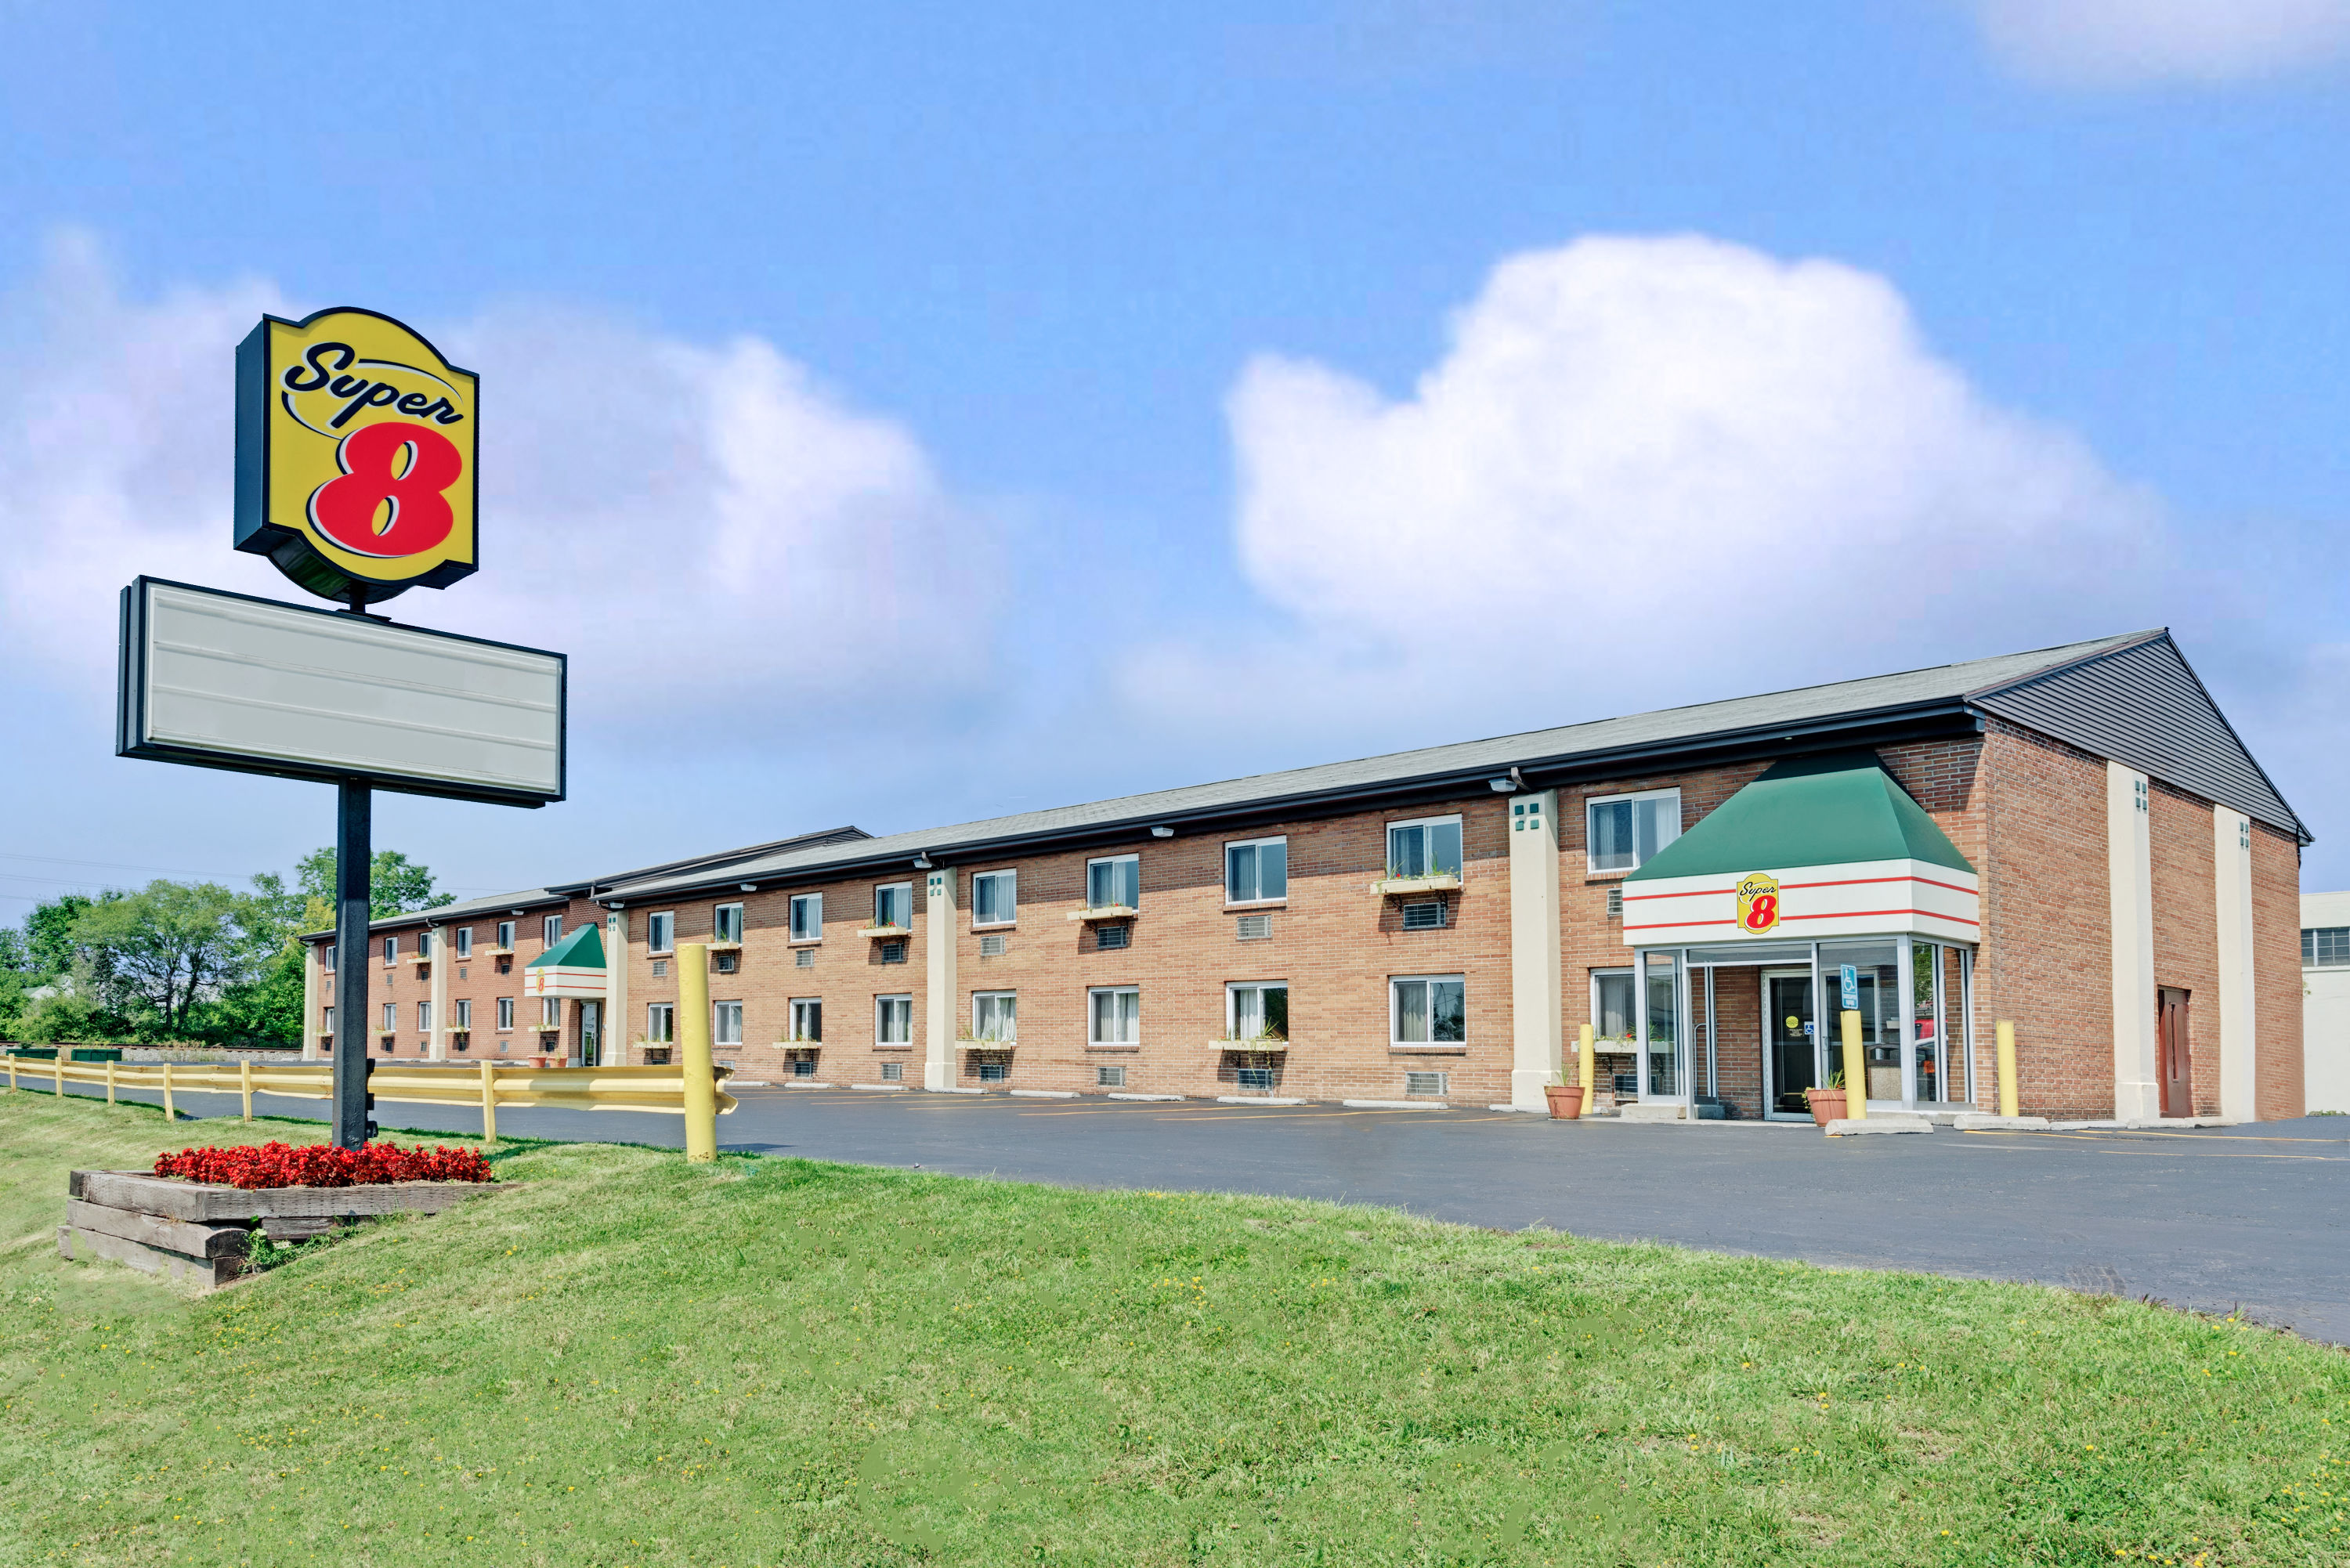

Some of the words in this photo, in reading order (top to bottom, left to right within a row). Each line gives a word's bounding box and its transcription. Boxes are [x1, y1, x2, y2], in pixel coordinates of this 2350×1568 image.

[280, 341, 464, 429] Super
[306, 421, 462, 558] 8
[1739, 881, 1776, 902] Super
[1744, 894, 1777, 930] 8
[538, 977, 544, 991] 8
